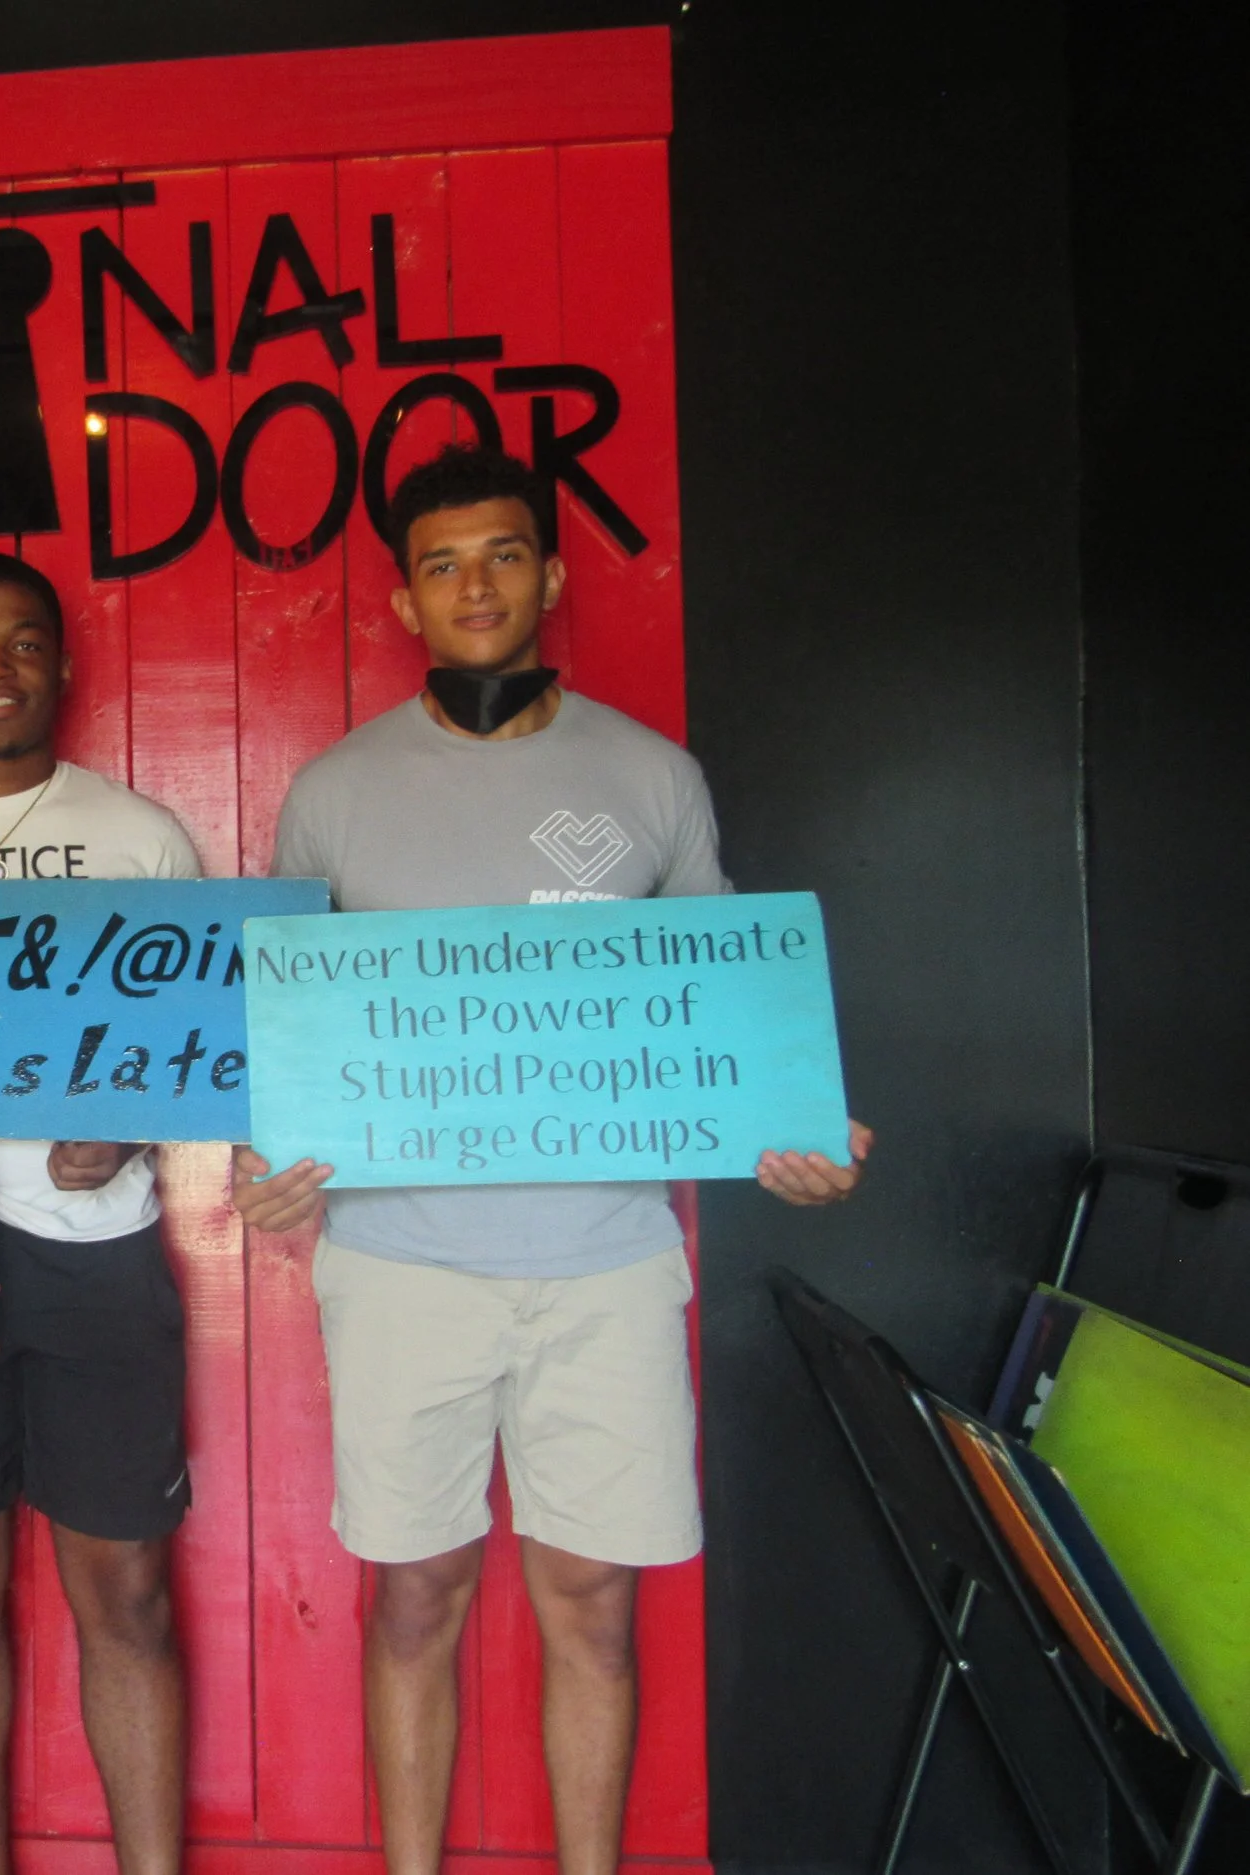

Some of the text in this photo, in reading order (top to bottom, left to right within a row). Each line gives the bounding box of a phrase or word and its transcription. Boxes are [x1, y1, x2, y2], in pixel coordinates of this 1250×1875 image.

[86, 363, 648, 580] DOOR
[256, 921, 808, 985] Never Underestimate
[364, 981, 702, 1039] the Power of
[340, 1045, 739, 1110] Stupid People in
[366, 1114, 721, 1171] Large Groups
